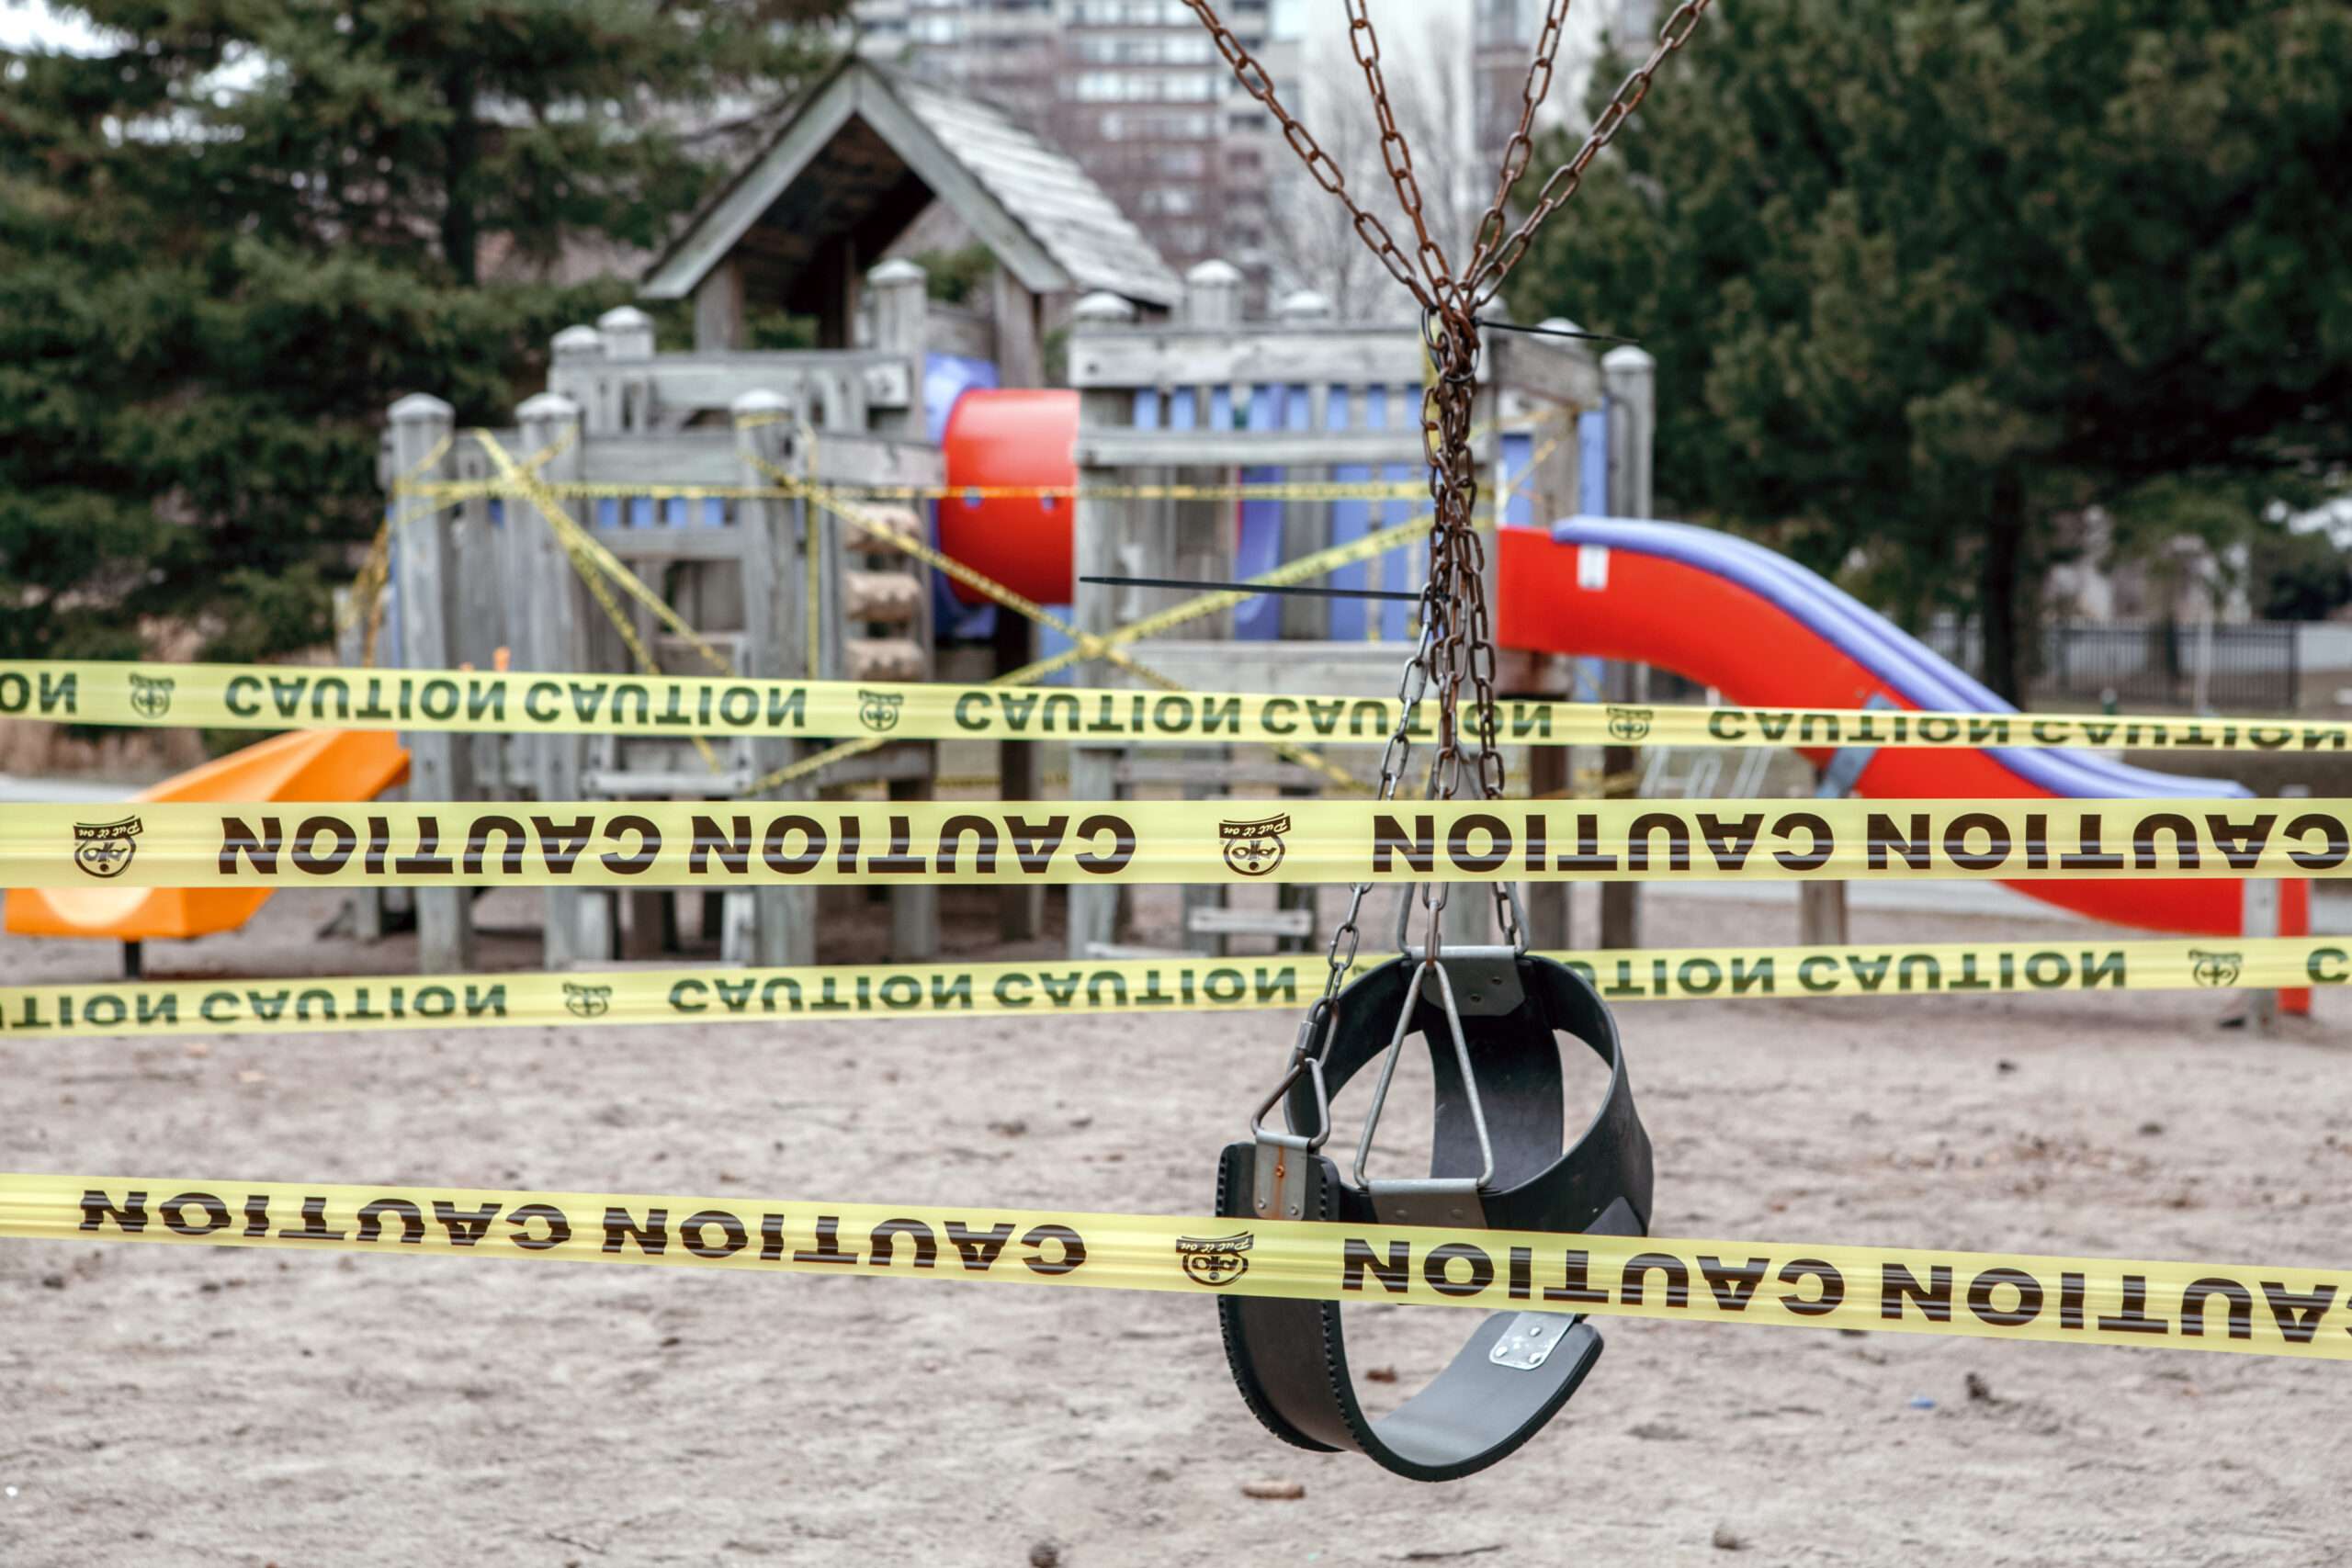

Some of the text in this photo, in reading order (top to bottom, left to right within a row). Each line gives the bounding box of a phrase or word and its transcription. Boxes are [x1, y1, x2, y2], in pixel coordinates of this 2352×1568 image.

[78, 822, 141, 839] Put it on
[219, 815, 1136, 875] CAUTION CAUTION
[1224, 819, 1288, 837] Put it on
[1373, 813, 2350, 873] CAUTION CAUTION
[79, 1190, 1086, 1275] CAUTION CAUTION
[1180, 1236, 1251, 1251] Put it on
[1342, 1238, 2352, 1344] AUTION CAUTION
